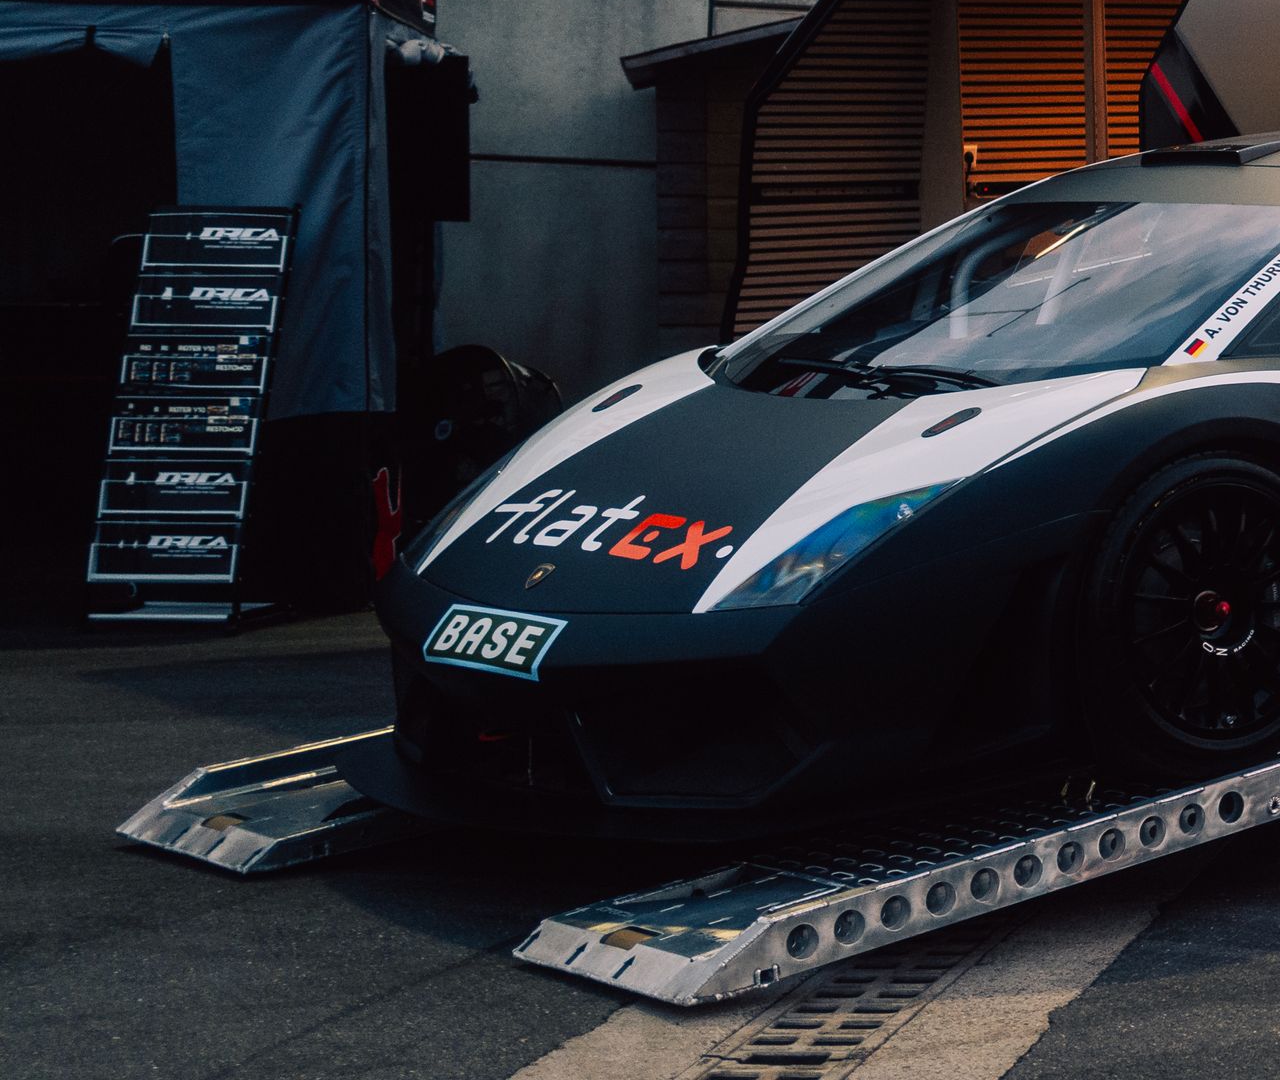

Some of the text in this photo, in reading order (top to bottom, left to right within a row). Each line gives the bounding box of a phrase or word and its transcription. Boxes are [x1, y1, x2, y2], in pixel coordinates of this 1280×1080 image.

[198, 227, 280, 241] ORCA
[188, 286, 270, 301] ORCA
[1204, 325, 1223, 340] A.
[1217, 296, 1248, 322] VON
[155, 471, 236, 486] ORCA
[147, 535, 229, 549] ORCA
[433, 614, 546, 665] BASE
